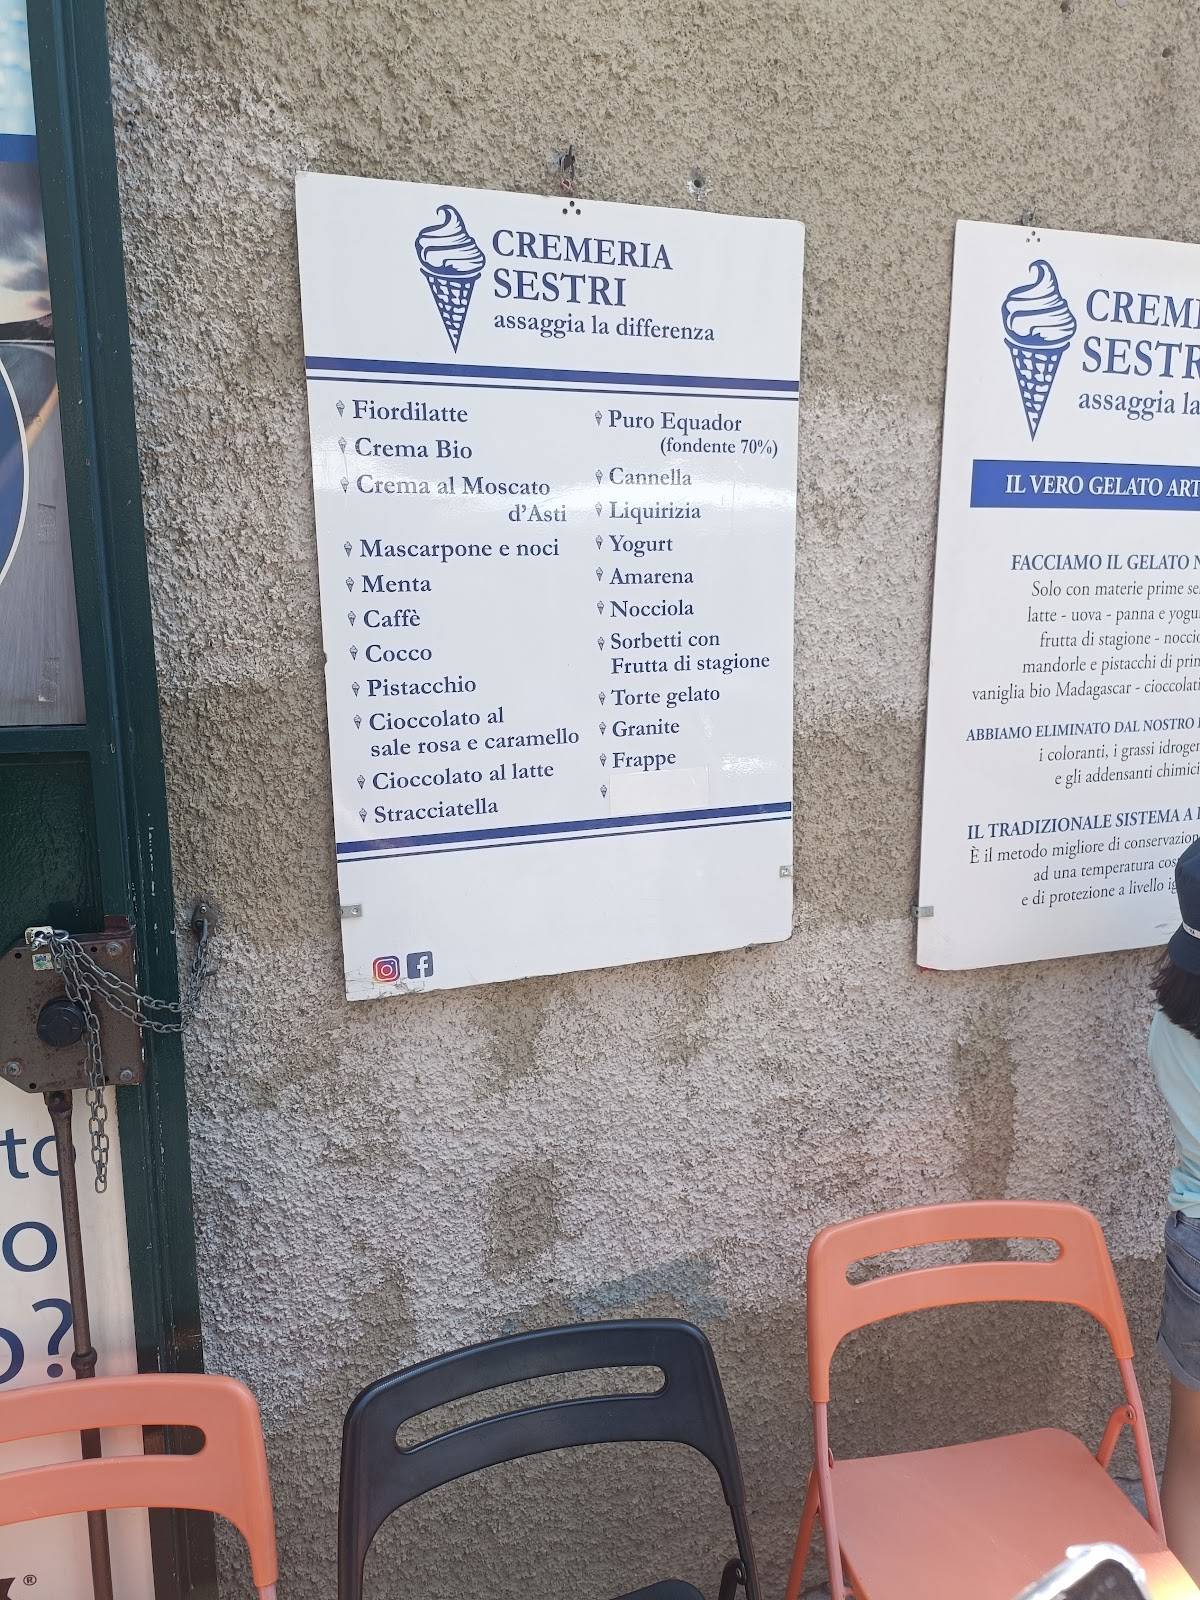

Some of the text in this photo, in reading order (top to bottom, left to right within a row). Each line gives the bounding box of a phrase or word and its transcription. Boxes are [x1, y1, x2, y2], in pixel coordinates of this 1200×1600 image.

[492, 229, 674, 271] CREMERIA
[493, 267, 627, 308] SESTRI
[1085, 288, 1200, 330] CREM
[493, 312, 715, 341] assaggia la differenza
[351, 399, 468, 423] Fiordilatte
[1078, 389, 1200, 422] assaggia la
[607, 409, 742, 437] Puro Equador
[354, 437, 473, 459] Crema Bio
[660, 436, 778, 460] (fondente 70%)
[356, 474, 551, 496] Crema al Moscato
[608, 466, 693, 486] Cannella
[1004, 474, 1027, 494] IL
[1029, 474, 1084, 495] VERO
[1088, 475, 1164, 497] GELATO
[608, 501, 702, 525] Liquirizia
[359, 538, 560, 564] Mascarpone e noci
[608, 534, 673, 558] Yogurt
[1010, 553, 1103, 571] FACCIAMO
[1106, 554, 1123, 570] IL
[1126, 554, 1190, 570] GELATO
[361, 574, 432, 593] Menta
[608, 567, 694, 585] Amarena
[1031, 579, 1200, 601] Solo con materie prime se
[363, 608, 421, 628] Caffè
[609, 598, 695, 618] Nocciola
[1027, 605, 1057, 623] latte
[1071, 610, 1103, 622] uova
[1115, 610, 1155, 626] panna
[1158, 609, 1166, 620] e
[1167, 609, 1200, 625] yogu
[610, 630, 721, 650] Sorbetti con
[1039, 630, 1078, 648] frutta
[1081, 629, 1095, 647] di
[1098, 631, 1151, 651] stagione
[365, 644, 433, 663] Cocco
[610, 652, 770, 675] Frutta di stagione
[1022, 655, 1087, 674] mandorle
[1090, 661, 1098, 671] e
[1100, 653, 1156, 676] pistacchi
[1160, 652, 1172, 669] di
[366, 675, 477, 697] Pistacchio
[610, 685, 720, 709] Torte gelato
[972, 682, 1025, 705] vaniglia
[1029, 681, 1051, 699] bio
[1055, 679, 1132, 701] Madagascar
[369, 706, 504, 731] Cioccolato al
[611, 718, 680, 738] Granite
[965, 725, 1032, 742] ABBIAMO
[1034, 721, 1111, 738] ELIMINATO
[1114, 720, 1138, 734] DAL
[1142, 717, 1195, 732] NOSTRO
[370, 727, 580, 758] sale rosa e caramello
[1038, 747, 1044, 762] i
[1047, 744, 1109, 762] coloranti,
[1113, 743, 1118, 758] i
[1120, 741, 1155, 762] grassi
[611, 751, 677, 772] Frappe
[372, 762, 554, 790] Cioccolato al latte
[1054, 775, 1062, 785] e
[1065, 768, 1081, 790] gli
[1085, 765, 1153, 783] addensanti
[374, 797, 499, 824] Stracciatella
[967, 824, 985, 840] IL
[987, 813, 1112, 839] TRADIZIONALE
[1115, 808, 1181, 828] SISTEMA
[1182, 807, 1194, 822] A
[969, 845, 980, 864] È
[983, 846, 993, 863] il
[997, 842, 1048, 862] metodo
[1051, 839, 1105, 860] migliore
[1107, 835, 1120, 852] di
[1033, 865, 1049, 882] ad
[1053, 868, 1077, 880] una
[1081, 860, 1155, 880] temperatura
[1021, 896, 1029, 907] e
[1032, 889, 1045, 905] di
[1048, 887, 1116, 909] protezione
[1118, 886, 1125, 896] a
[1128, 877, 1164, 895] livello
